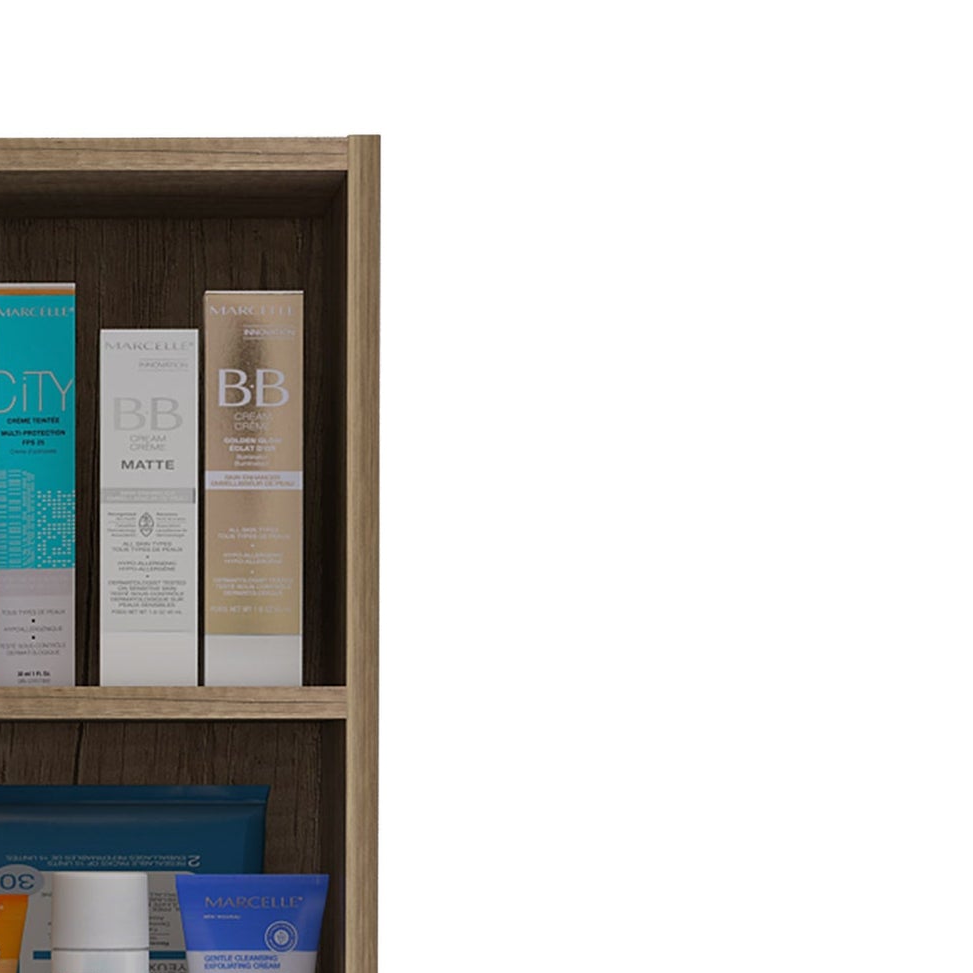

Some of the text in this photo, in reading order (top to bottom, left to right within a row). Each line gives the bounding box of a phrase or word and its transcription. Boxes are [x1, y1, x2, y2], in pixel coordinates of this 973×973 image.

[121, 459, 176, 470] MATTE
[188, 856, 200, 867] 2
[0, 874, 35, 890] 30
[205, 896, 298, 909] MARCELLE
